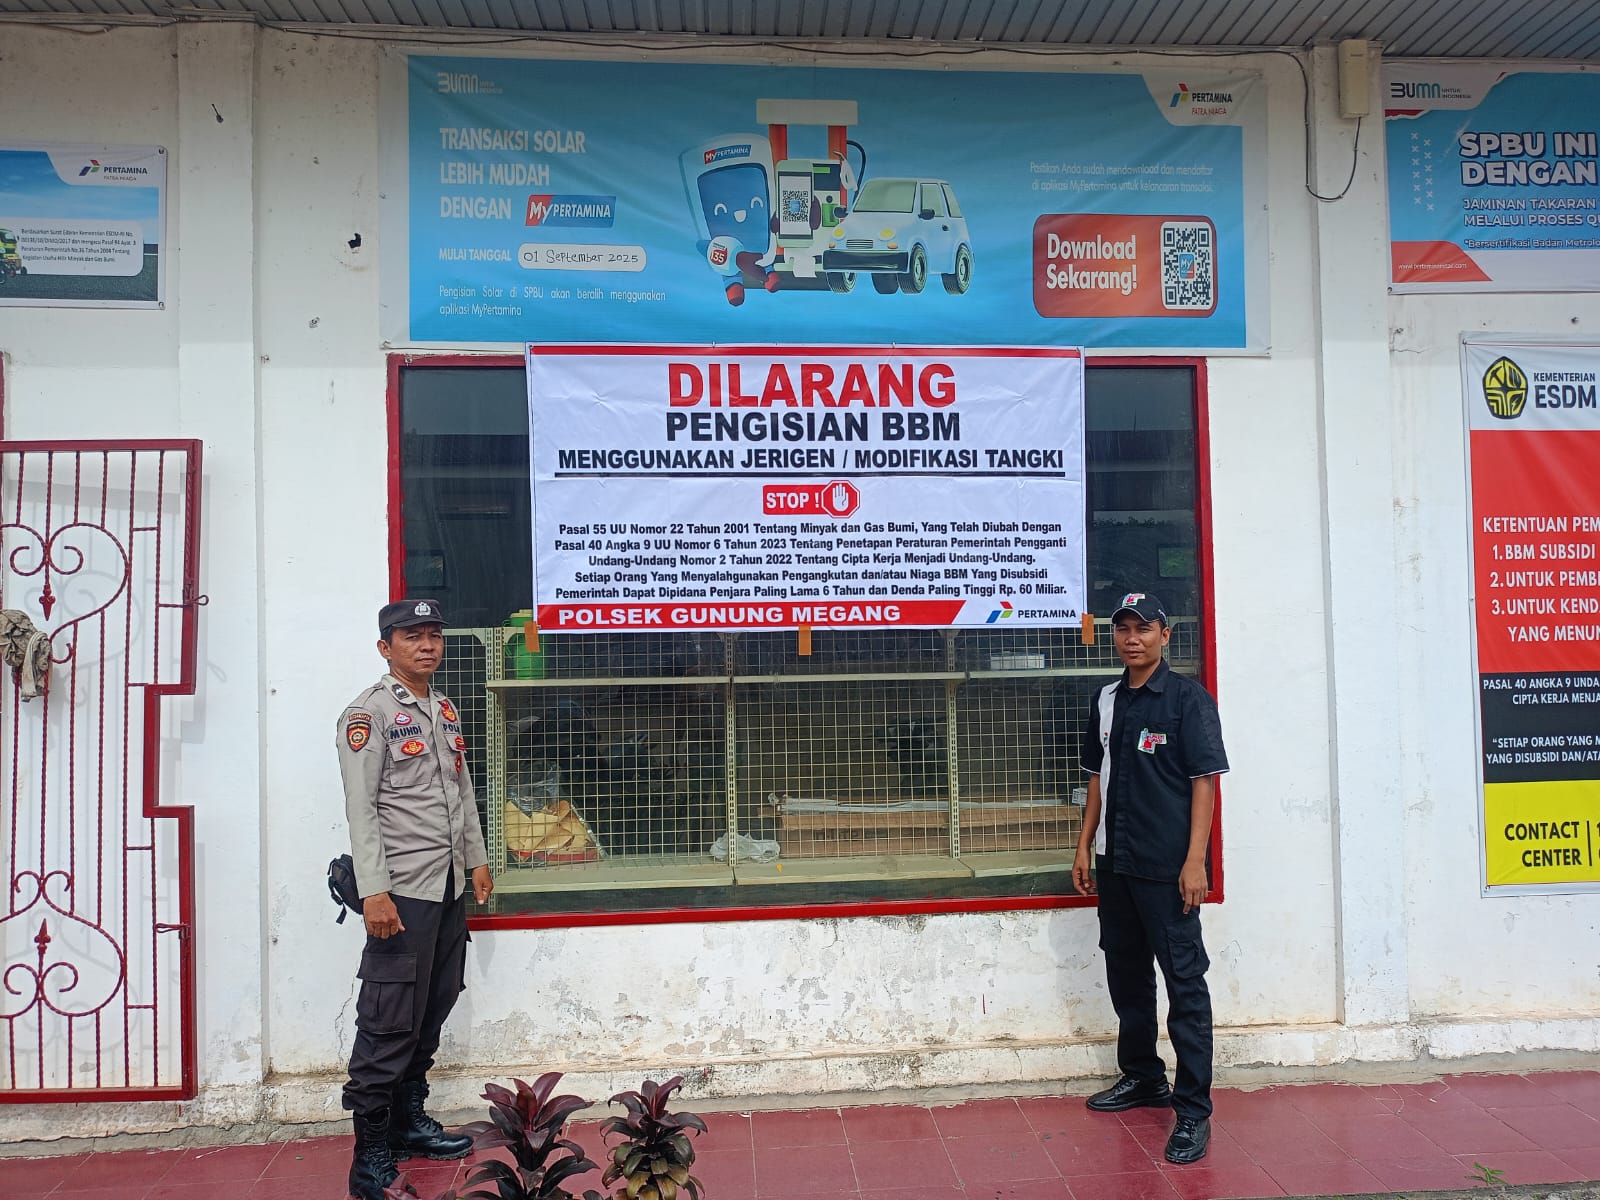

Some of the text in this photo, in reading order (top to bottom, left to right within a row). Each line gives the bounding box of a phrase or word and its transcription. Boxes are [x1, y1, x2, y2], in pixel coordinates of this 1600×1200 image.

[437, 72, 479, 94] BUMN
[1391, 83, 1440, 98] BUMN
[1192, 93, 1232, 103] PERTAMINA
[439, 128, 586, 153] TRANSAKSI SOLAR
[1459, 133, 1597, 157] SPBU INI
[440, 162, 550, 186] LEBIH MUDAH
[1461, 161, 1597, 185] DENGAN
[440, 196, 610, 223] DENGAN MyPERTAMINA
[1463, 199, 1596, 210] JAMINAN TAKARAN
[1464, 215, 1583, 226] MELALUI PROSES
[1047, 233, 1137, 260] Download
[1533, 239, 1562, 247] Badan
[439, 248, 512, 261] MULAI TANGGAL
[524, 249, 639, 264] 01 September 2025
[1046, 264, 1137, 296] Sekarang!
[439, 285, 666, 303] Pengisian Solar di SPBU akan beralih menggunakan
[439, 305, 521, 318] aplikasi MyPertamina
[1534, 372, 1596, 382] KEMENTERIAN
[668, 363, 956, 408] DILARANG
[1535, 385, 1597, 409] ESDM
[666, 412, 960, 442] PENGISIAN BBM
[559, 449, 1063, 469] MENGGUNAKAN JERIGEN / MODIFIKASI TANGKI
[766, 492, 809, 509] STOP
[559, 522, 1061, 535] Pasal 55 UU Nomor 22 Tahun 2001 Tentang Minyak dan Gas Bumi, Yang Telah Diubah Dengan
[1483, 516, 1600, 533] KETENTUAN PEM
[555, 537, 1066, 552] Pasal 40 Angka 9 UU Nomor 6 Tahun 2023 Tentang Penetapan Peraturan Pemerintah Pengganti
[1540, 543, 1595, 559] SUBSIDI
[588, 553, 1036, 568] Undang-Undang Nomor 2 Tahun 2022 Tentang Cipta Kerja Menjadi Undang-Undang.
[575, 568, 1048, 584] Setiap Orang Yang Menyalahgunakan Pengangkutan dan/atau Niaga BBM Yang Disubsidi
[556, 584, 1067, 600] Pemerintah Dapat Dipidana Penjara Paling Lama 6 Tahun dan Denda Paling Tinggi Rp. 60 Miliar.
[558, 606, 901, 625] POLSEK GUNUNG MEGANG
[1018, 610, 1076, 618] PERTAMINA
[1508, 626, 1550, 642] YANG
[1483, 677, 1600, 690] PASAL 40 ANGKA 9 UNDA
[1512, 694, 1538, 705] CIPTA
[1541, 693, 1569, 704] KERJA
[390, 725, 422, 739] MUHDI
[1492, 735, 1592, 749] “SETIAP ORANG YANG
[1486, 752, 1559, 764] YANG DISUBSIDI
[1504, 821, 1579, 841] CONTACT
[1522, 849, 1582, 868] CENTER
